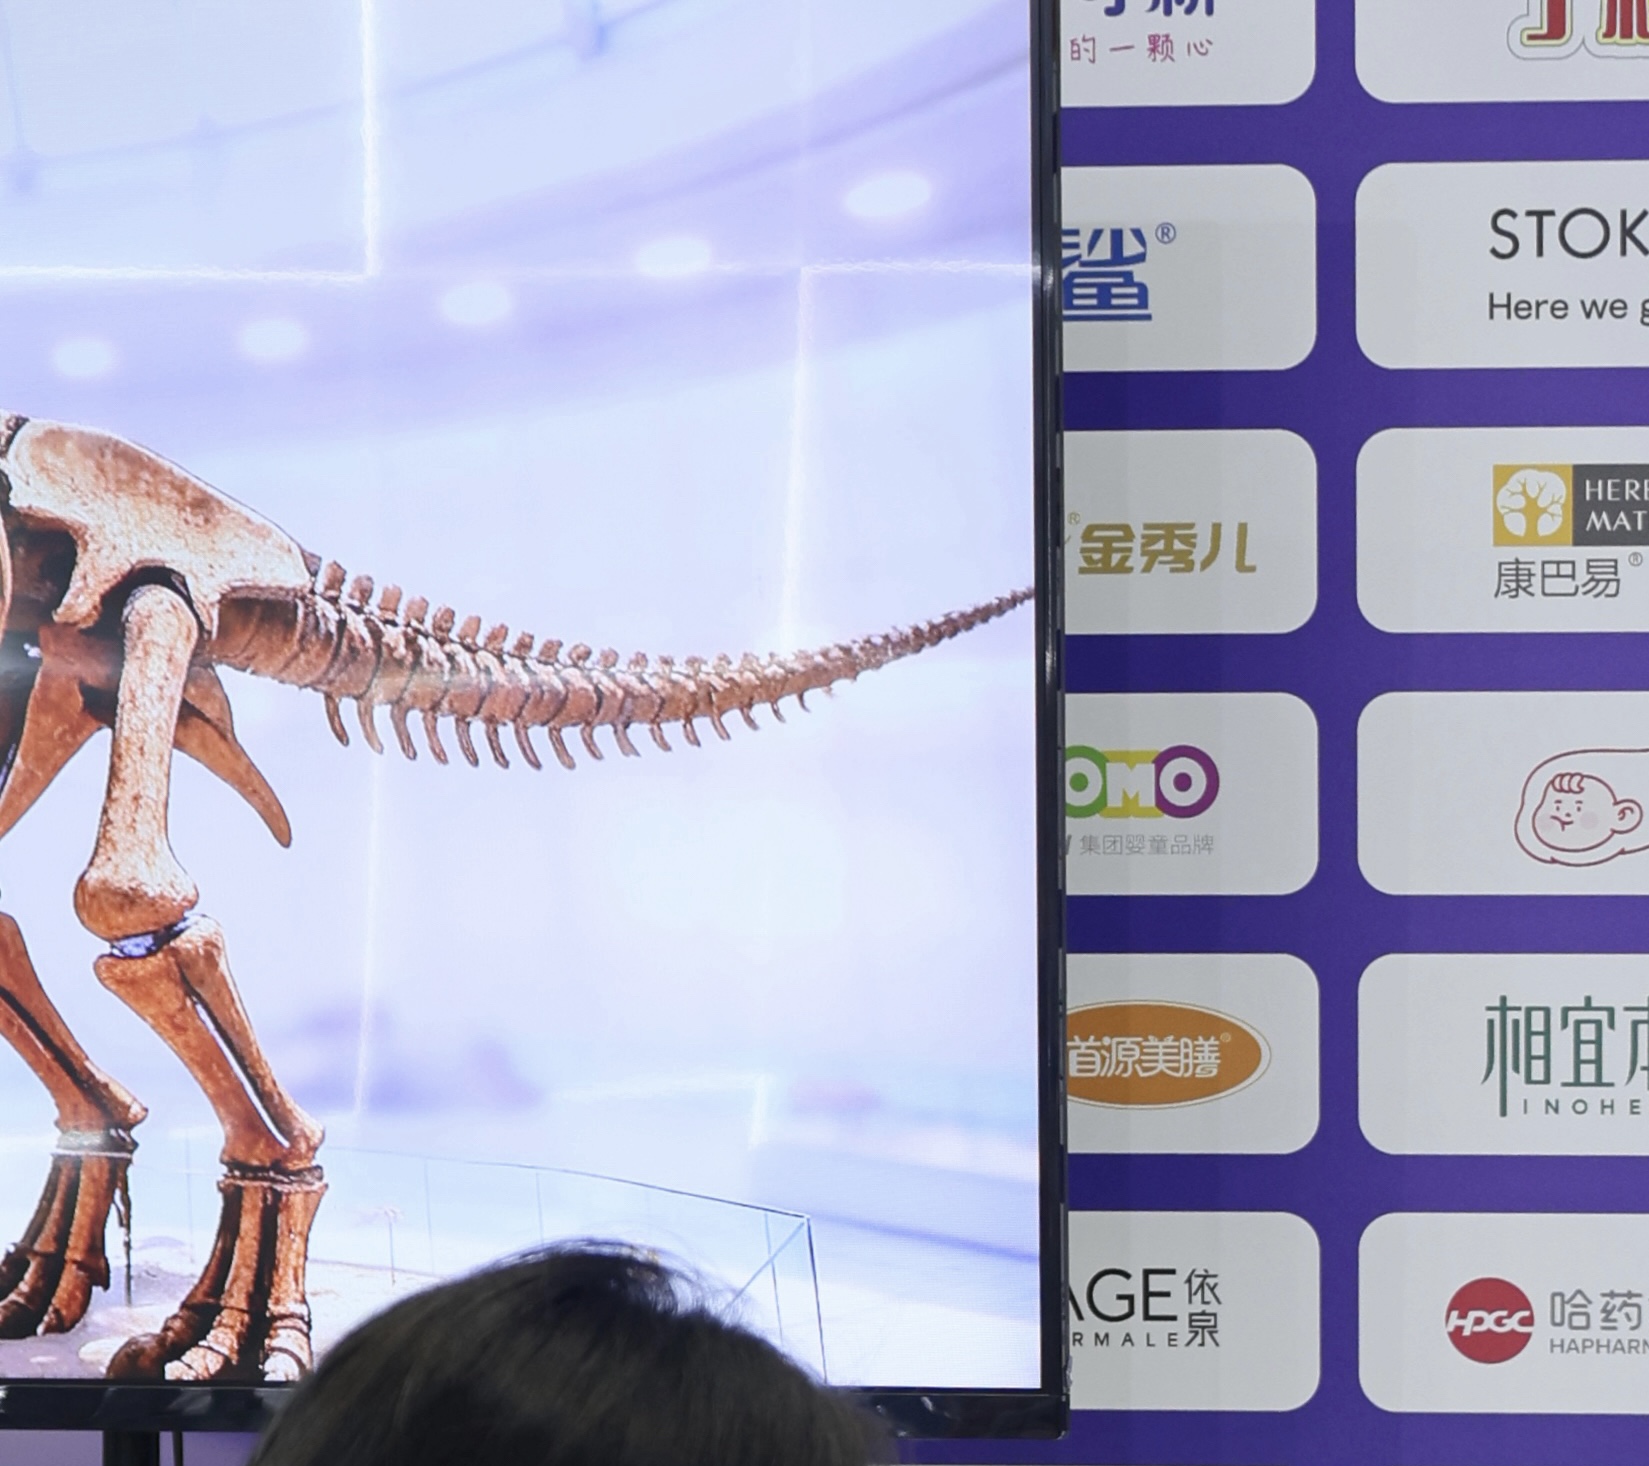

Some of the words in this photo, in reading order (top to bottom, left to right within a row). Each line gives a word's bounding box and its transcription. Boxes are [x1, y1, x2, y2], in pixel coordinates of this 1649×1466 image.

[1070, 34, 1213, 64] 的一颗心
[1489, 292, 1569, 320] Here
[1583, 299, 1629, 320] we
[1079, 522, 1256, 574] 金秀儿
[1494, 557, 1620, 599] 康巴易
[1080, 830, 1216, 859] 集团婴童品牌
[1184, 1269, 1221, 1347] 依泉
[1446, 1310, 1534, 1336] HPGC
